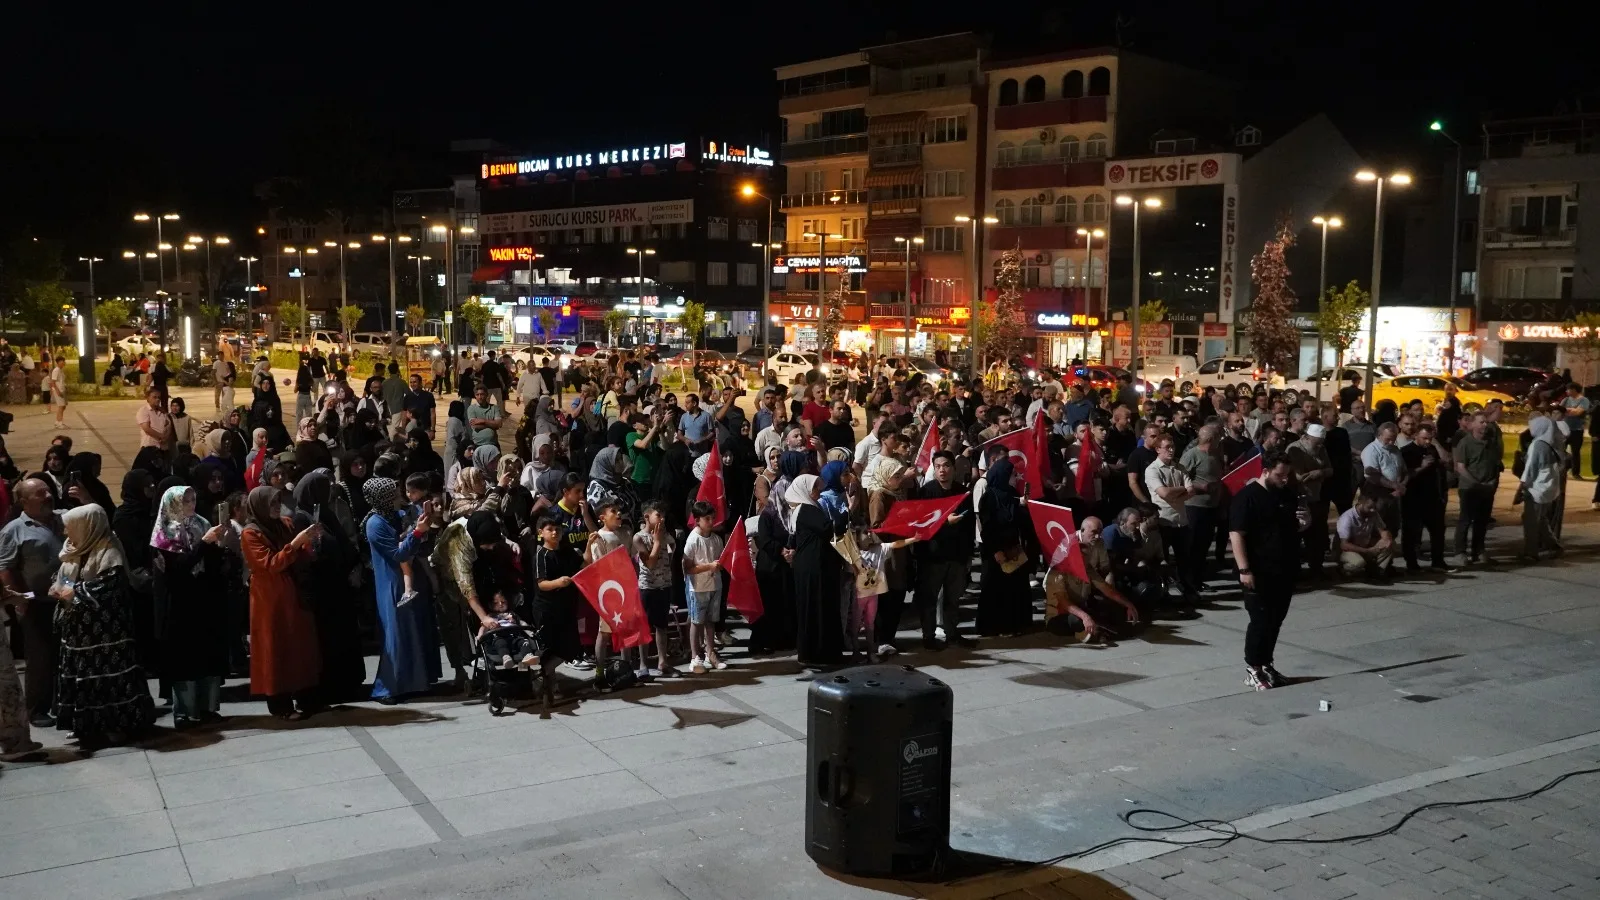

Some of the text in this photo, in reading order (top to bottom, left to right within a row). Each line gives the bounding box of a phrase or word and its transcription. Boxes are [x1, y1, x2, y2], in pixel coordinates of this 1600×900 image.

[519, 159, 549, 173] HOCAM
[556, 153, 592, 169] KURS
[1128, 158, 1198, 183] TEKSİF
[572, 209, 606, 225] KURSU
[608, 207, 637, 222] PARK
[490, 248, 515, 261] YAKIN
[1500, 302, 1592, 320] KONA
